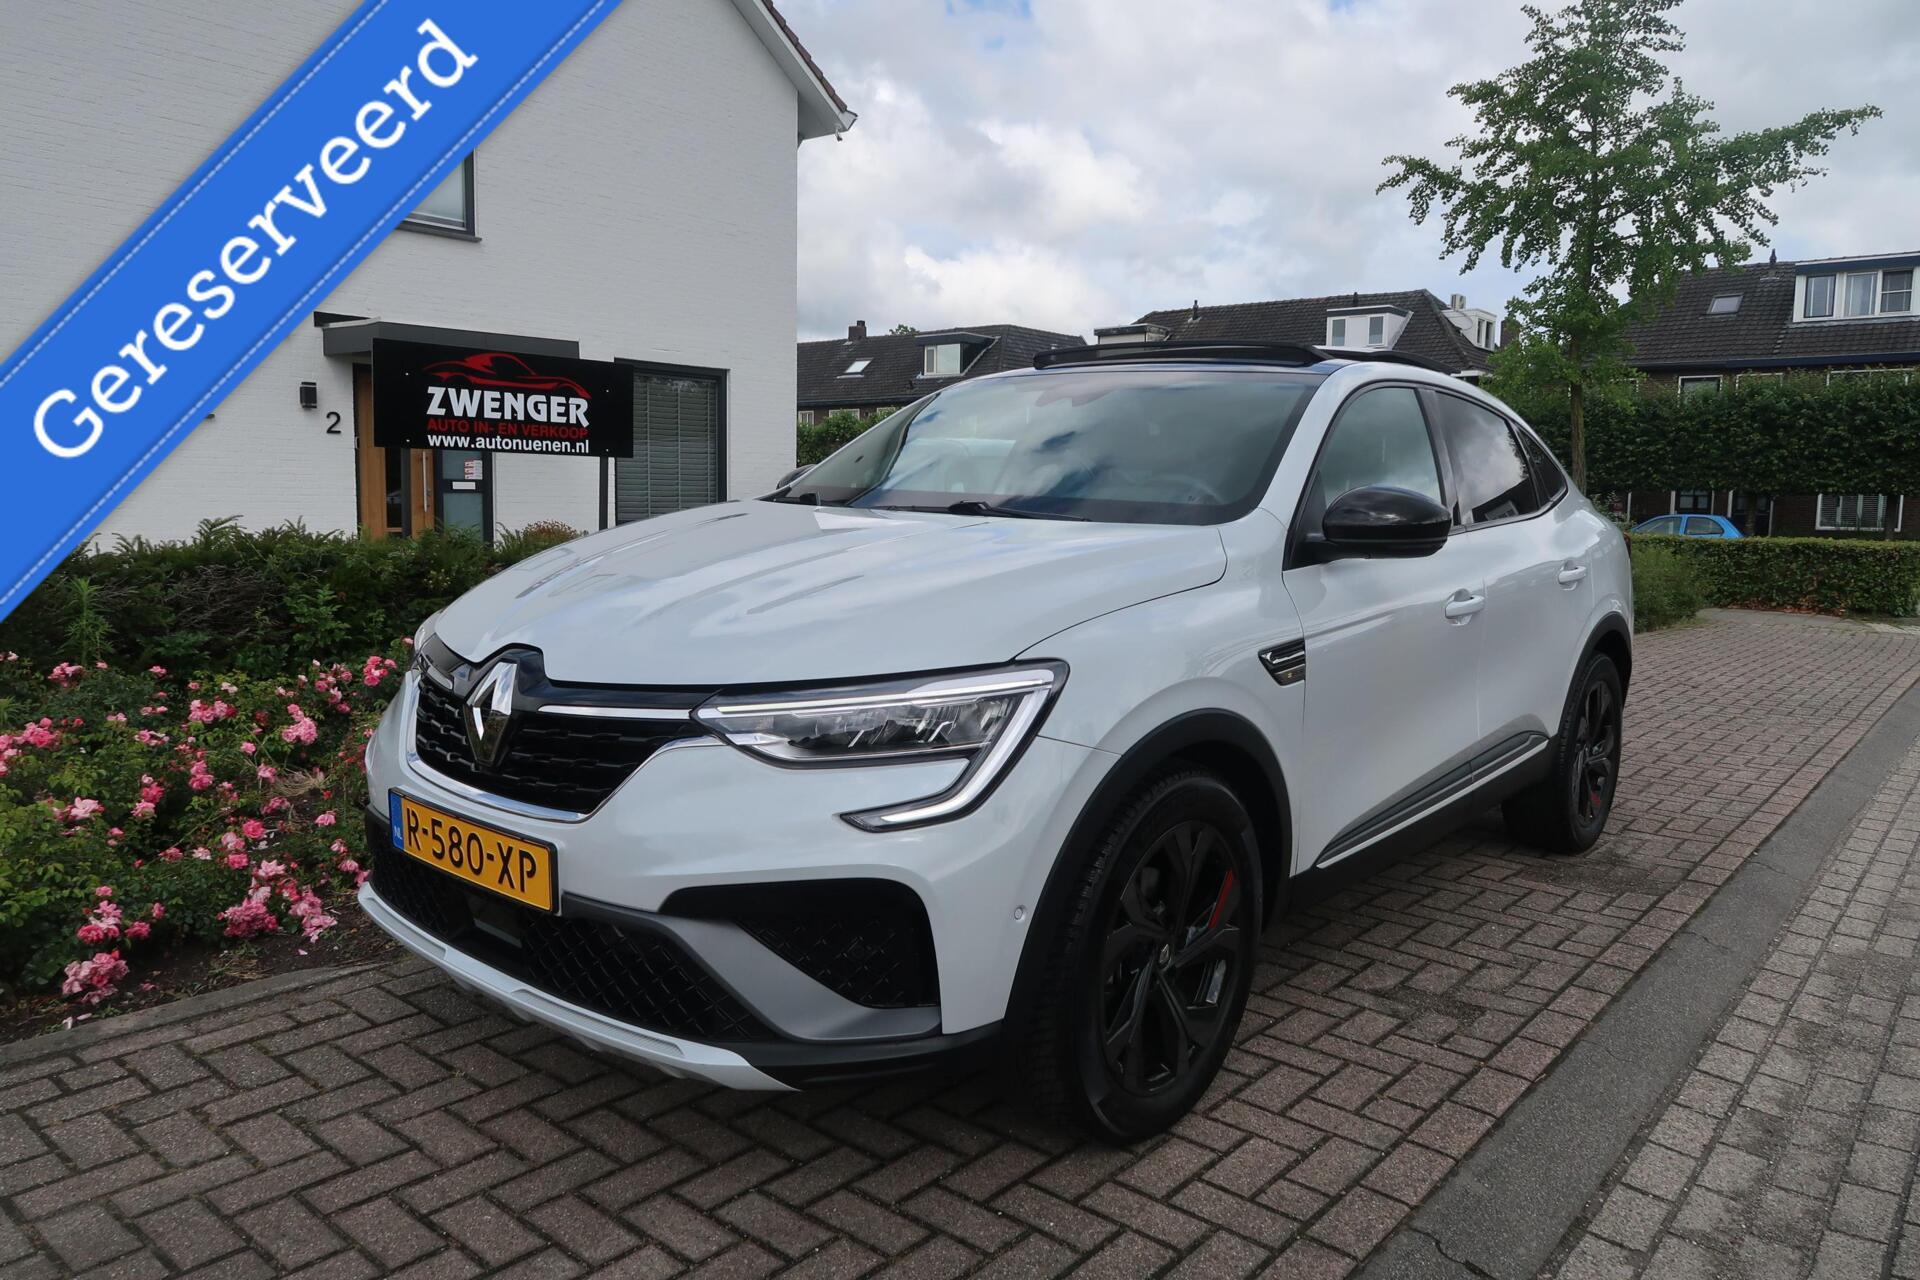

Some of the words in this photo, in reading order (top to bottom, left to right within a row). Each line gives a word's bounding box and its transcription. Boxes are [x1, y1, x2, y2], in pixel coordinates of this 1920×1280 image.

[426, 386, 590, 428] ZWENGER
[326, 411, 342, 434] 2
[427, 418, 469, 433] AUTO
[473, 421, 494, 434] IN-
[498, 422, 518, 436] EN
[520, 424, 589, 440] VERKOOP
[427, 435, 589, 453] www.autonuenen.nl
[393, 825, 403, 840] NL
[406, 807, 537, 893] R-580-XP
